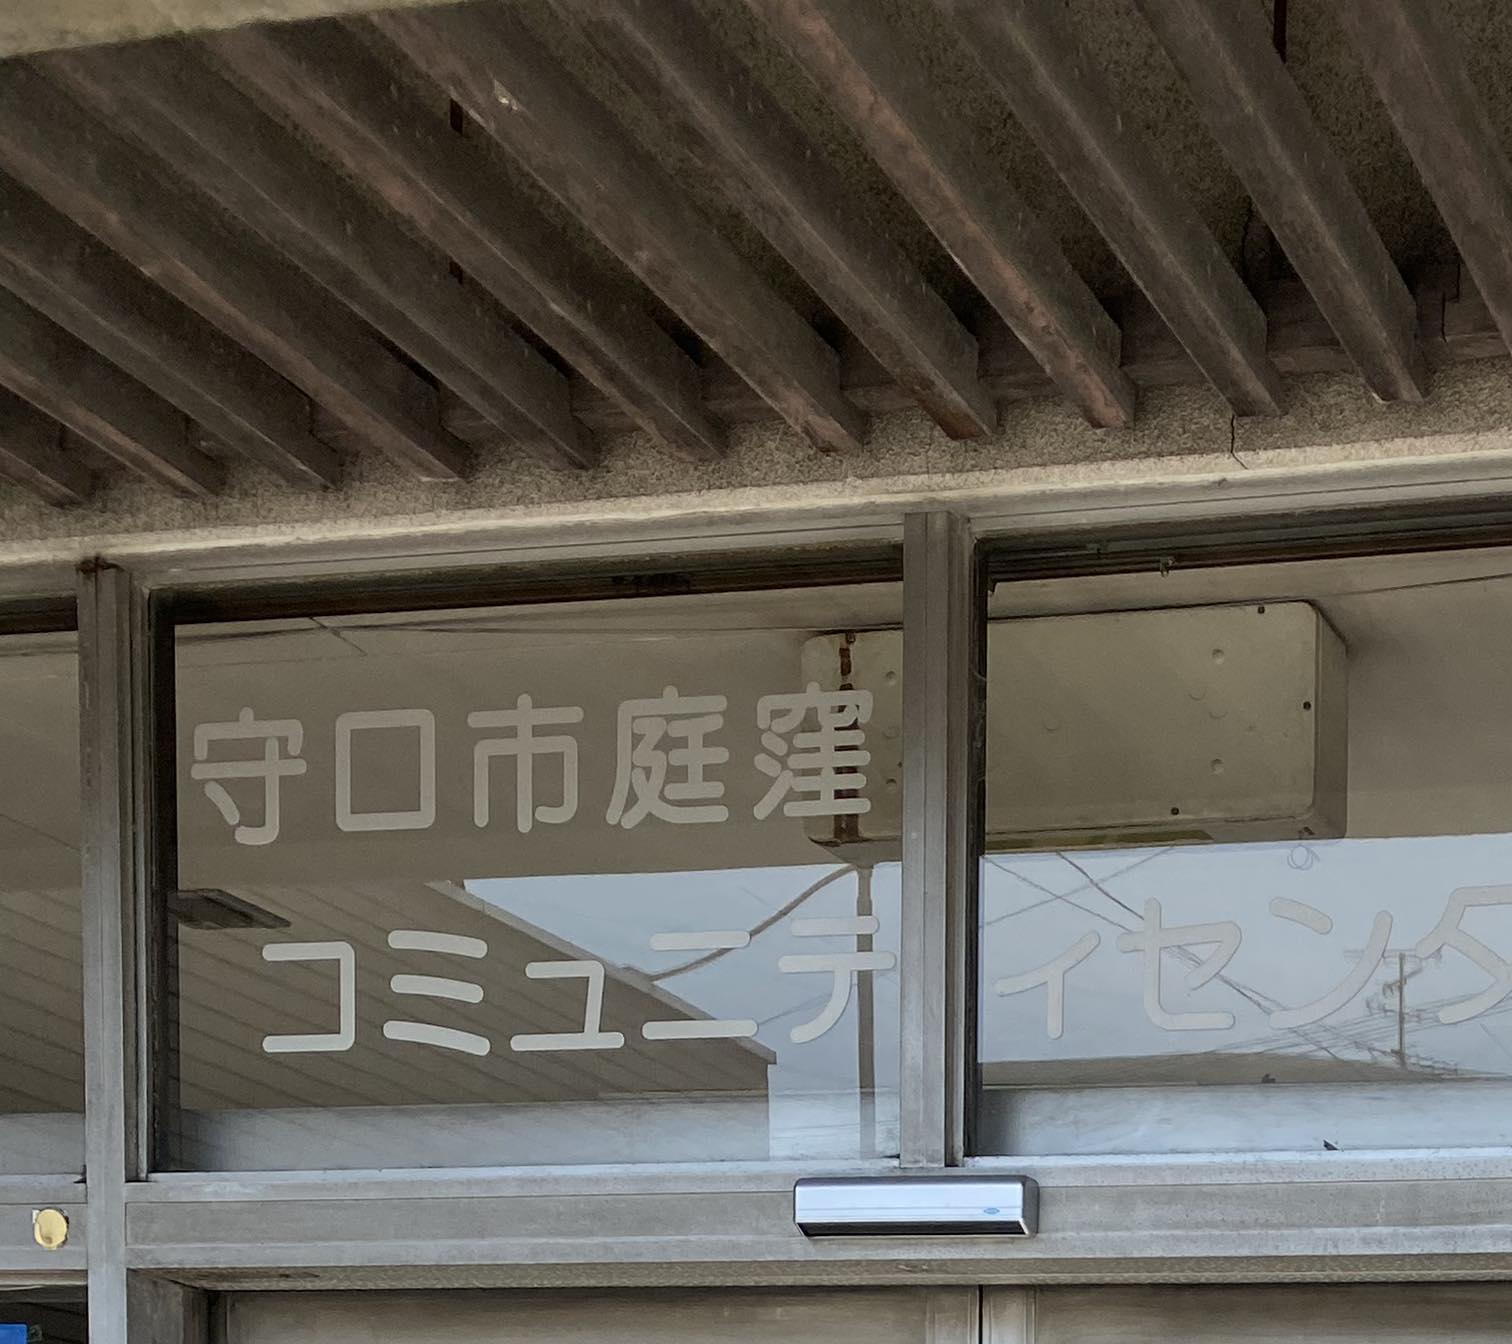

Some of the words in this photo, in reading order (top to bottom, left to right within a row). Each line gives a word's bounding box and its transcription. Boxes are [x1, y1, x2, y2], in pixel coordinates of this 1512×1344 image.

[189, 684, 876, 846] 守口市庭窪
